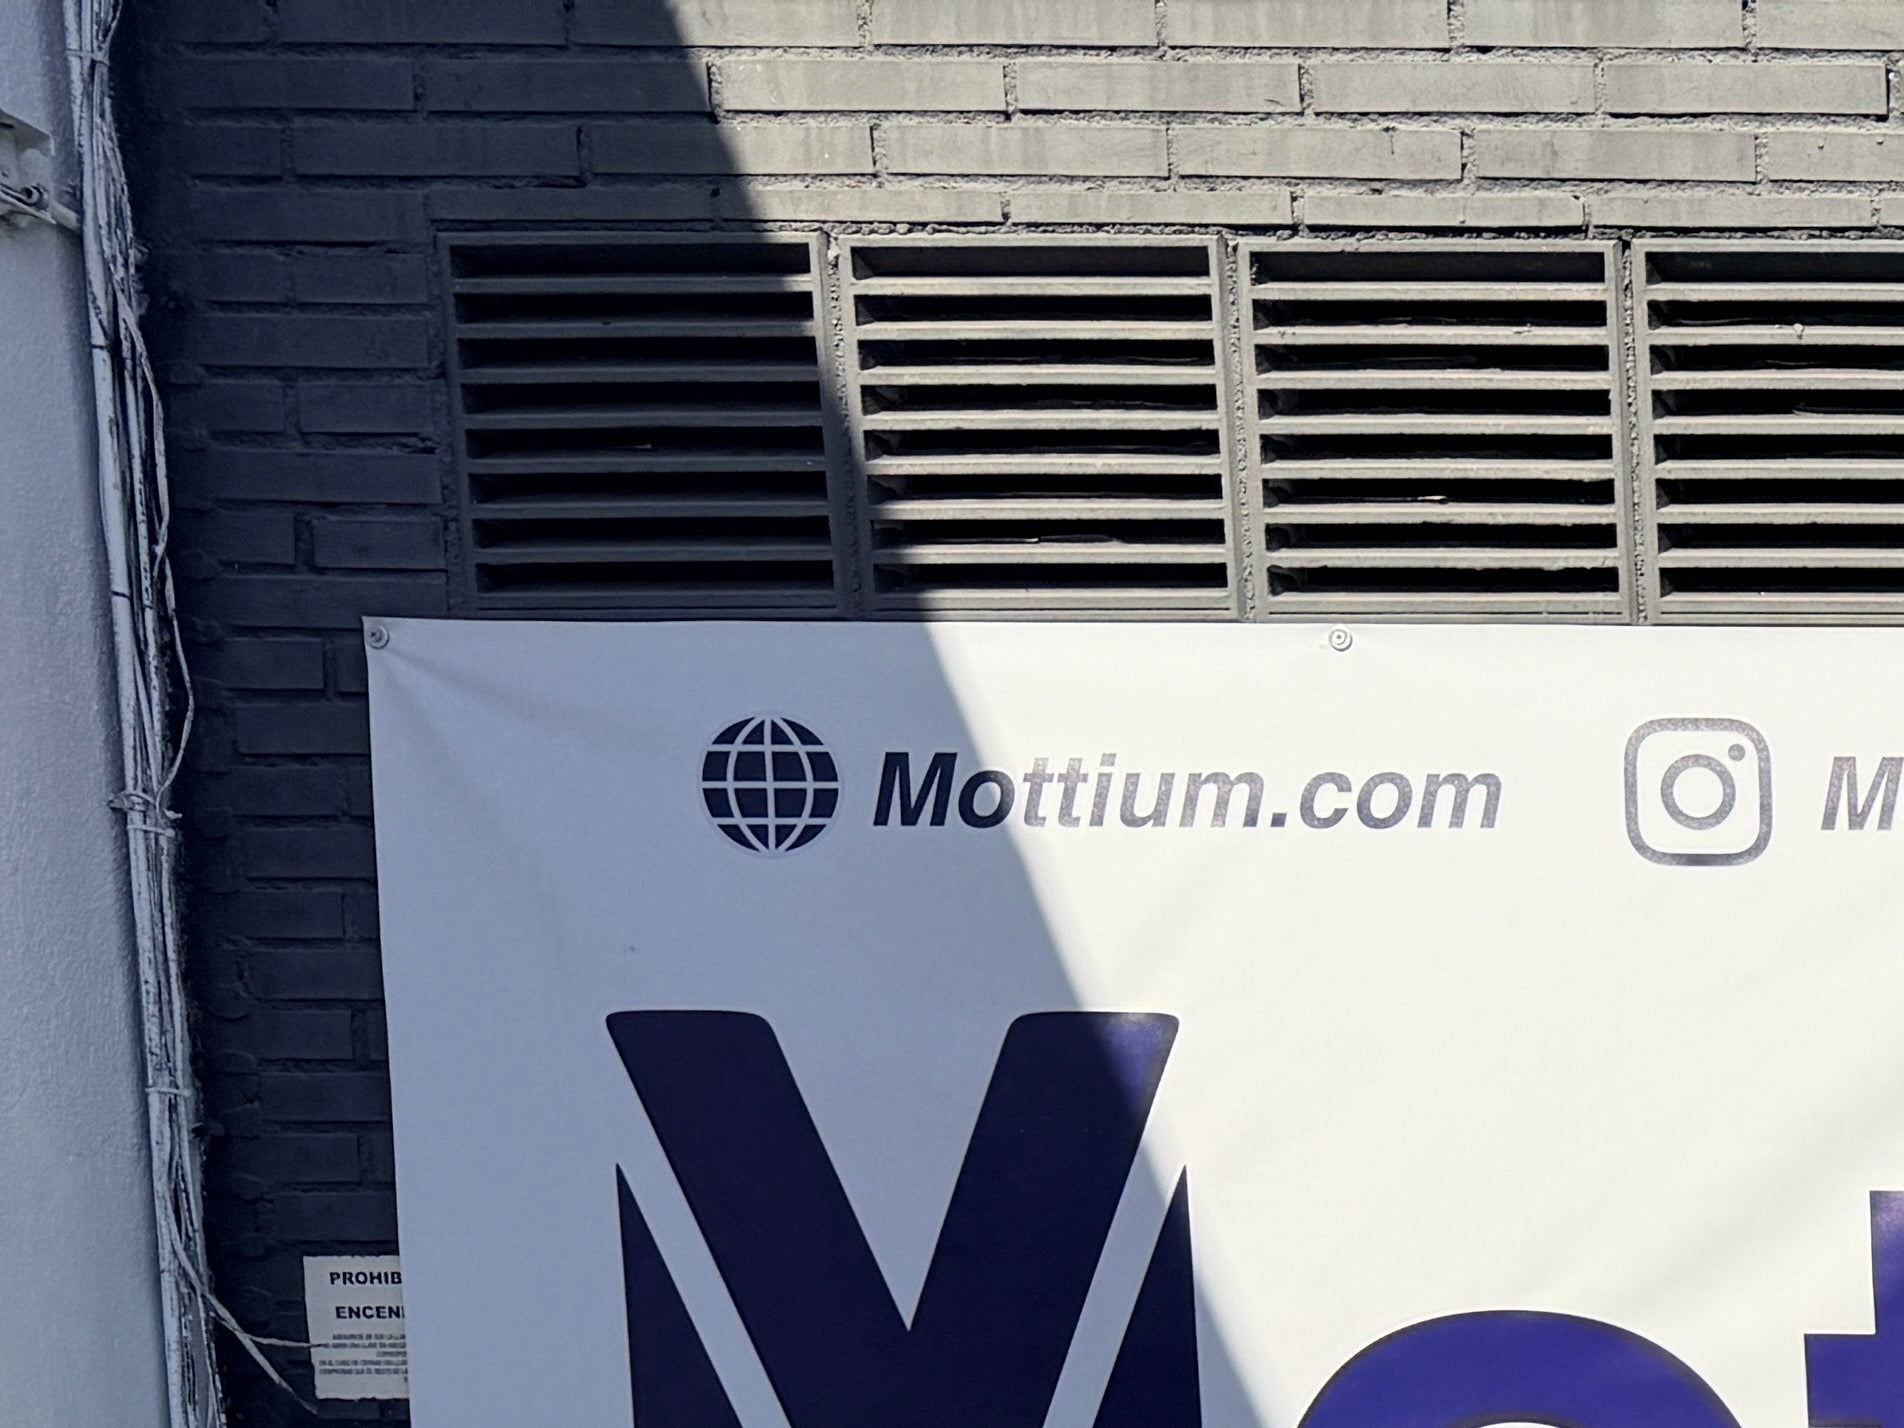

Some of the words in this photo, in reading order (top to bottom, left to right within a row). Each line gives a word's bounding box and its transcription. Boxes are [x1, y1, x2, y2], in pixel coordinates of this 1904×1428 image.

[873, 752, 1502, 831] Mottium.com
[329, 1271, 403, 1286] PROHIB
[335, 1306, 405, 1319] ENCEN
